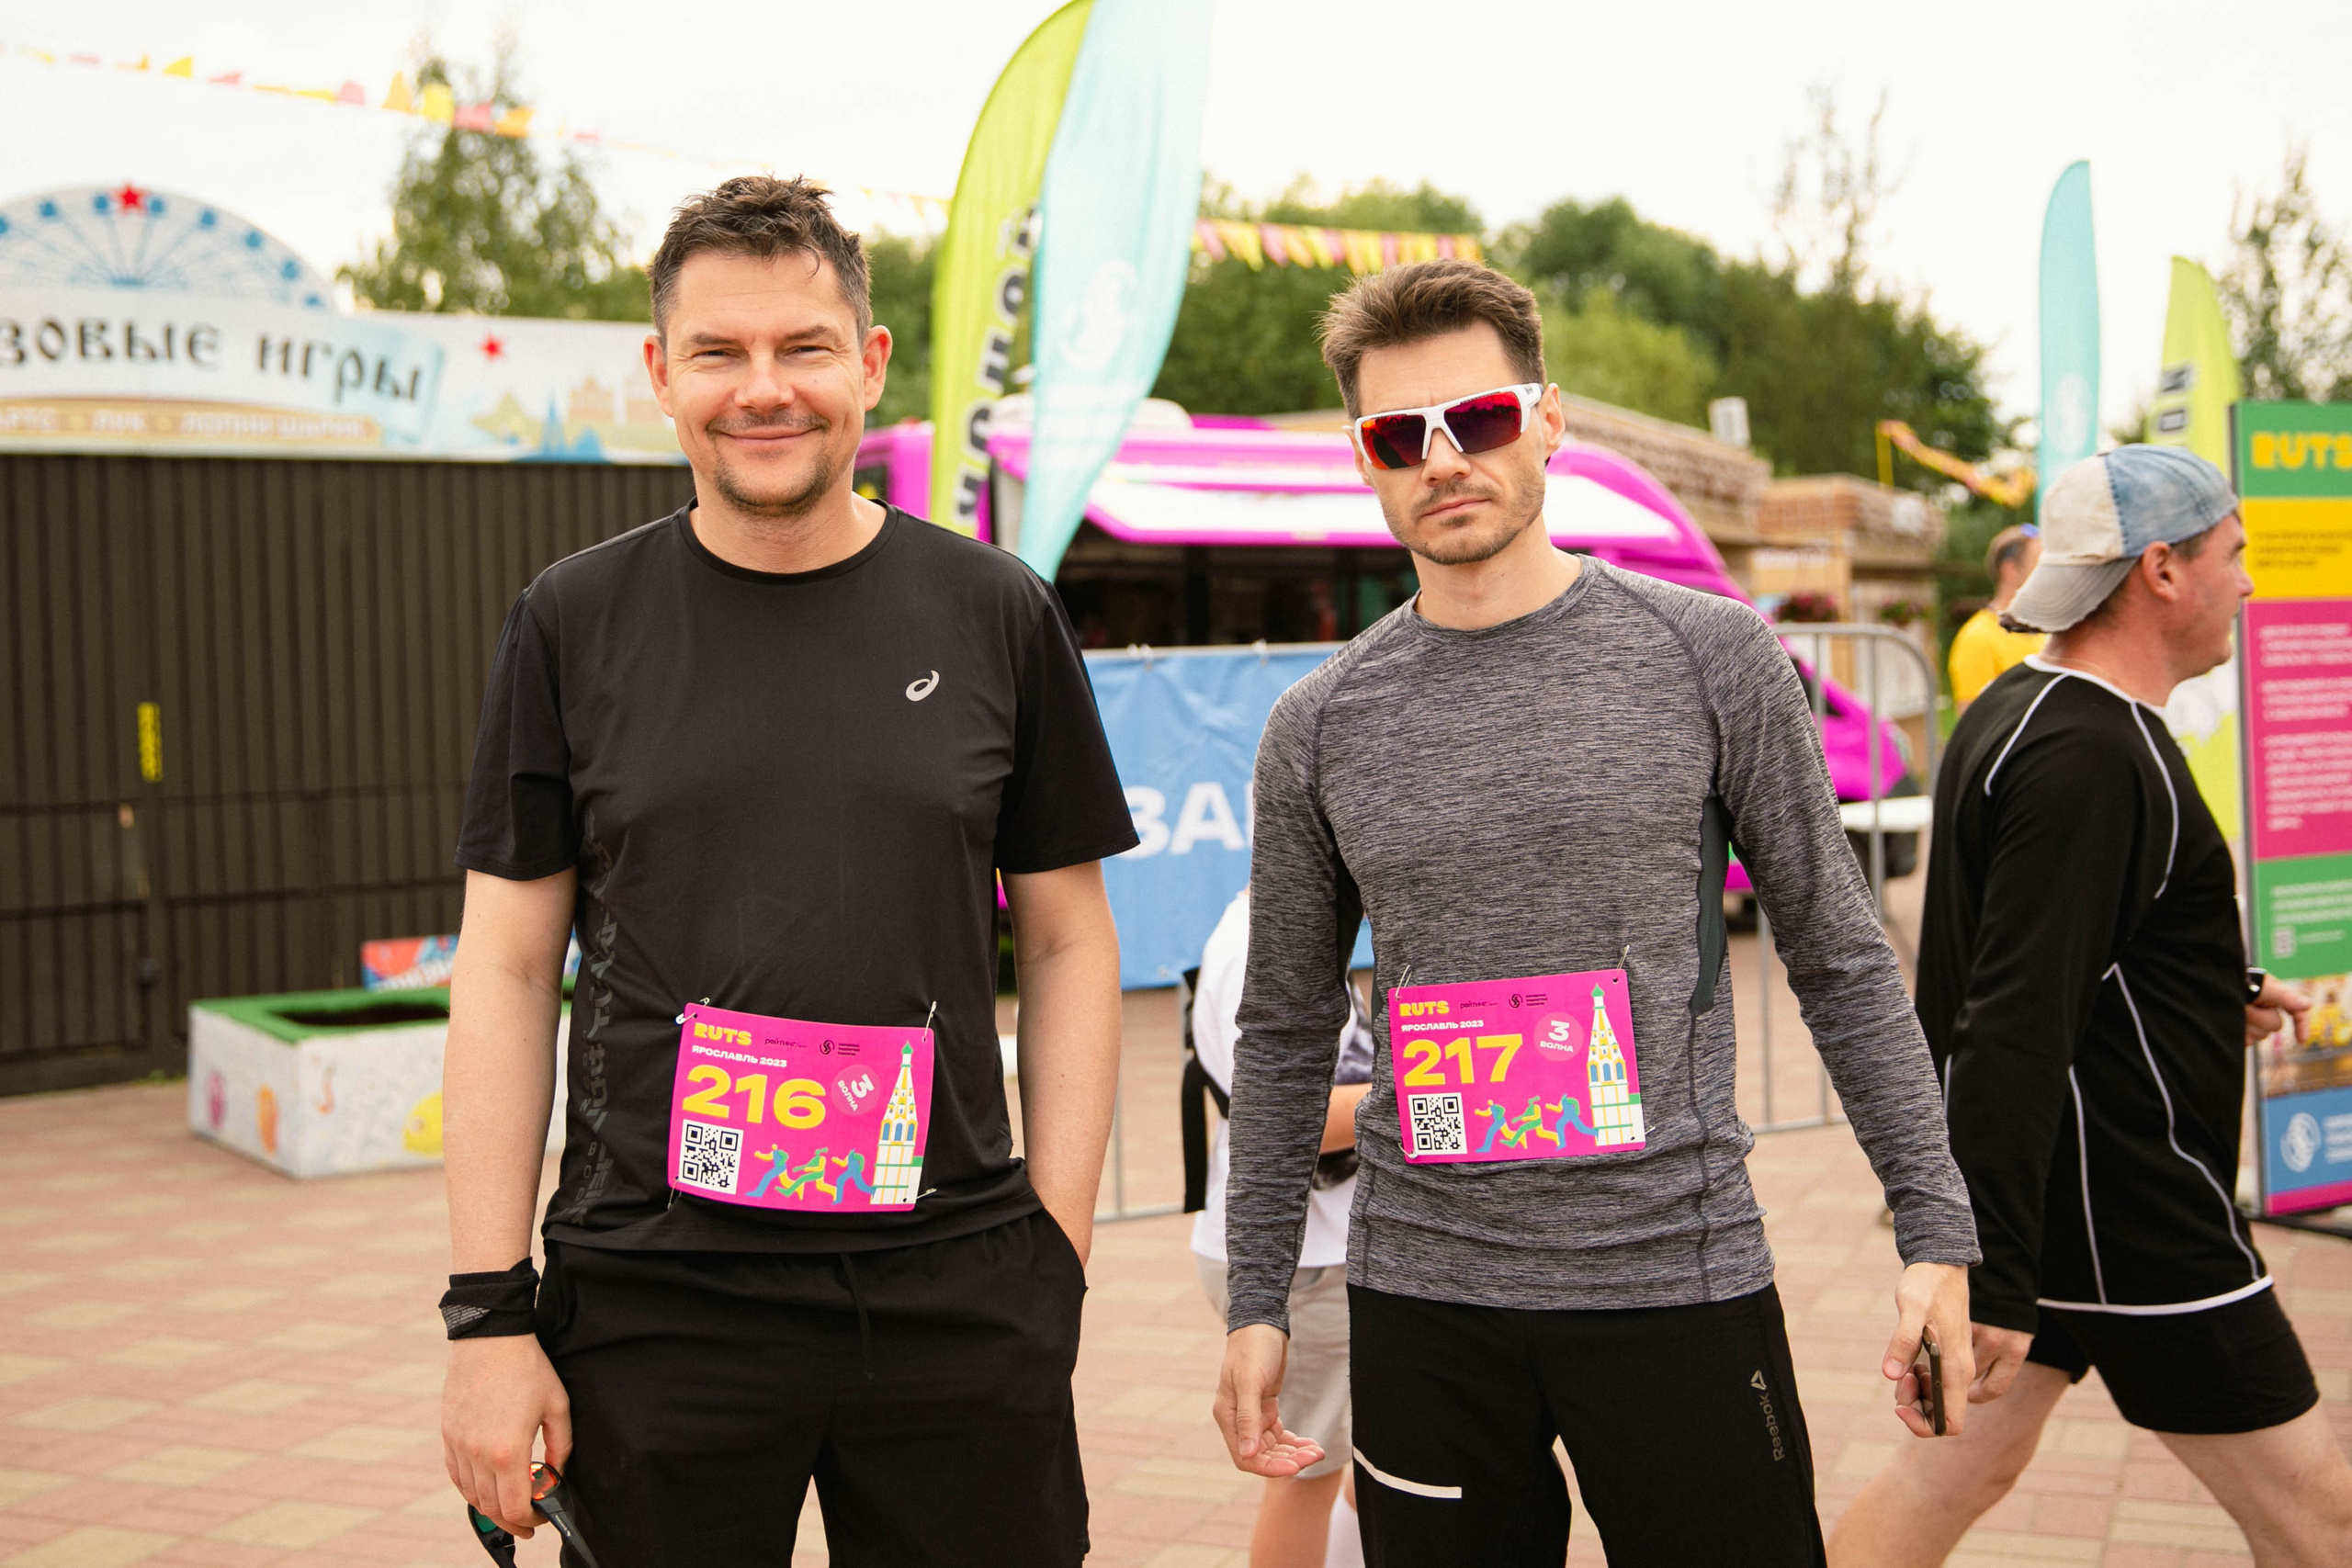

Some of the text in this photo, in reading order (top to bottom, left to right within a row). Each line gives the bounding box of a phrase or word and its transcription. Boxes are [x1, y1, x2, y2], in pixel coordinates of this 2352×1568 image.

[1399, 1000, 1450, 1017] RUTS
[694, 1022, 752, 1045] RUTS
[1401, 1020, 1484, 1032] ЯРОСЛАВЛЬ 2023
[692, 1045, 787, 1067] ЯРОСЛАВЛЬ 2023
[1539, 1040, 1574, 1053] ВОЛНА
[1403, 1033, 1523, 1087] 217
[683, 1065, 826, 1130] 216
[838, 1080, 858, 1111] ВОЛНА
[1758, 1393, 1785, 1461] Reebok
